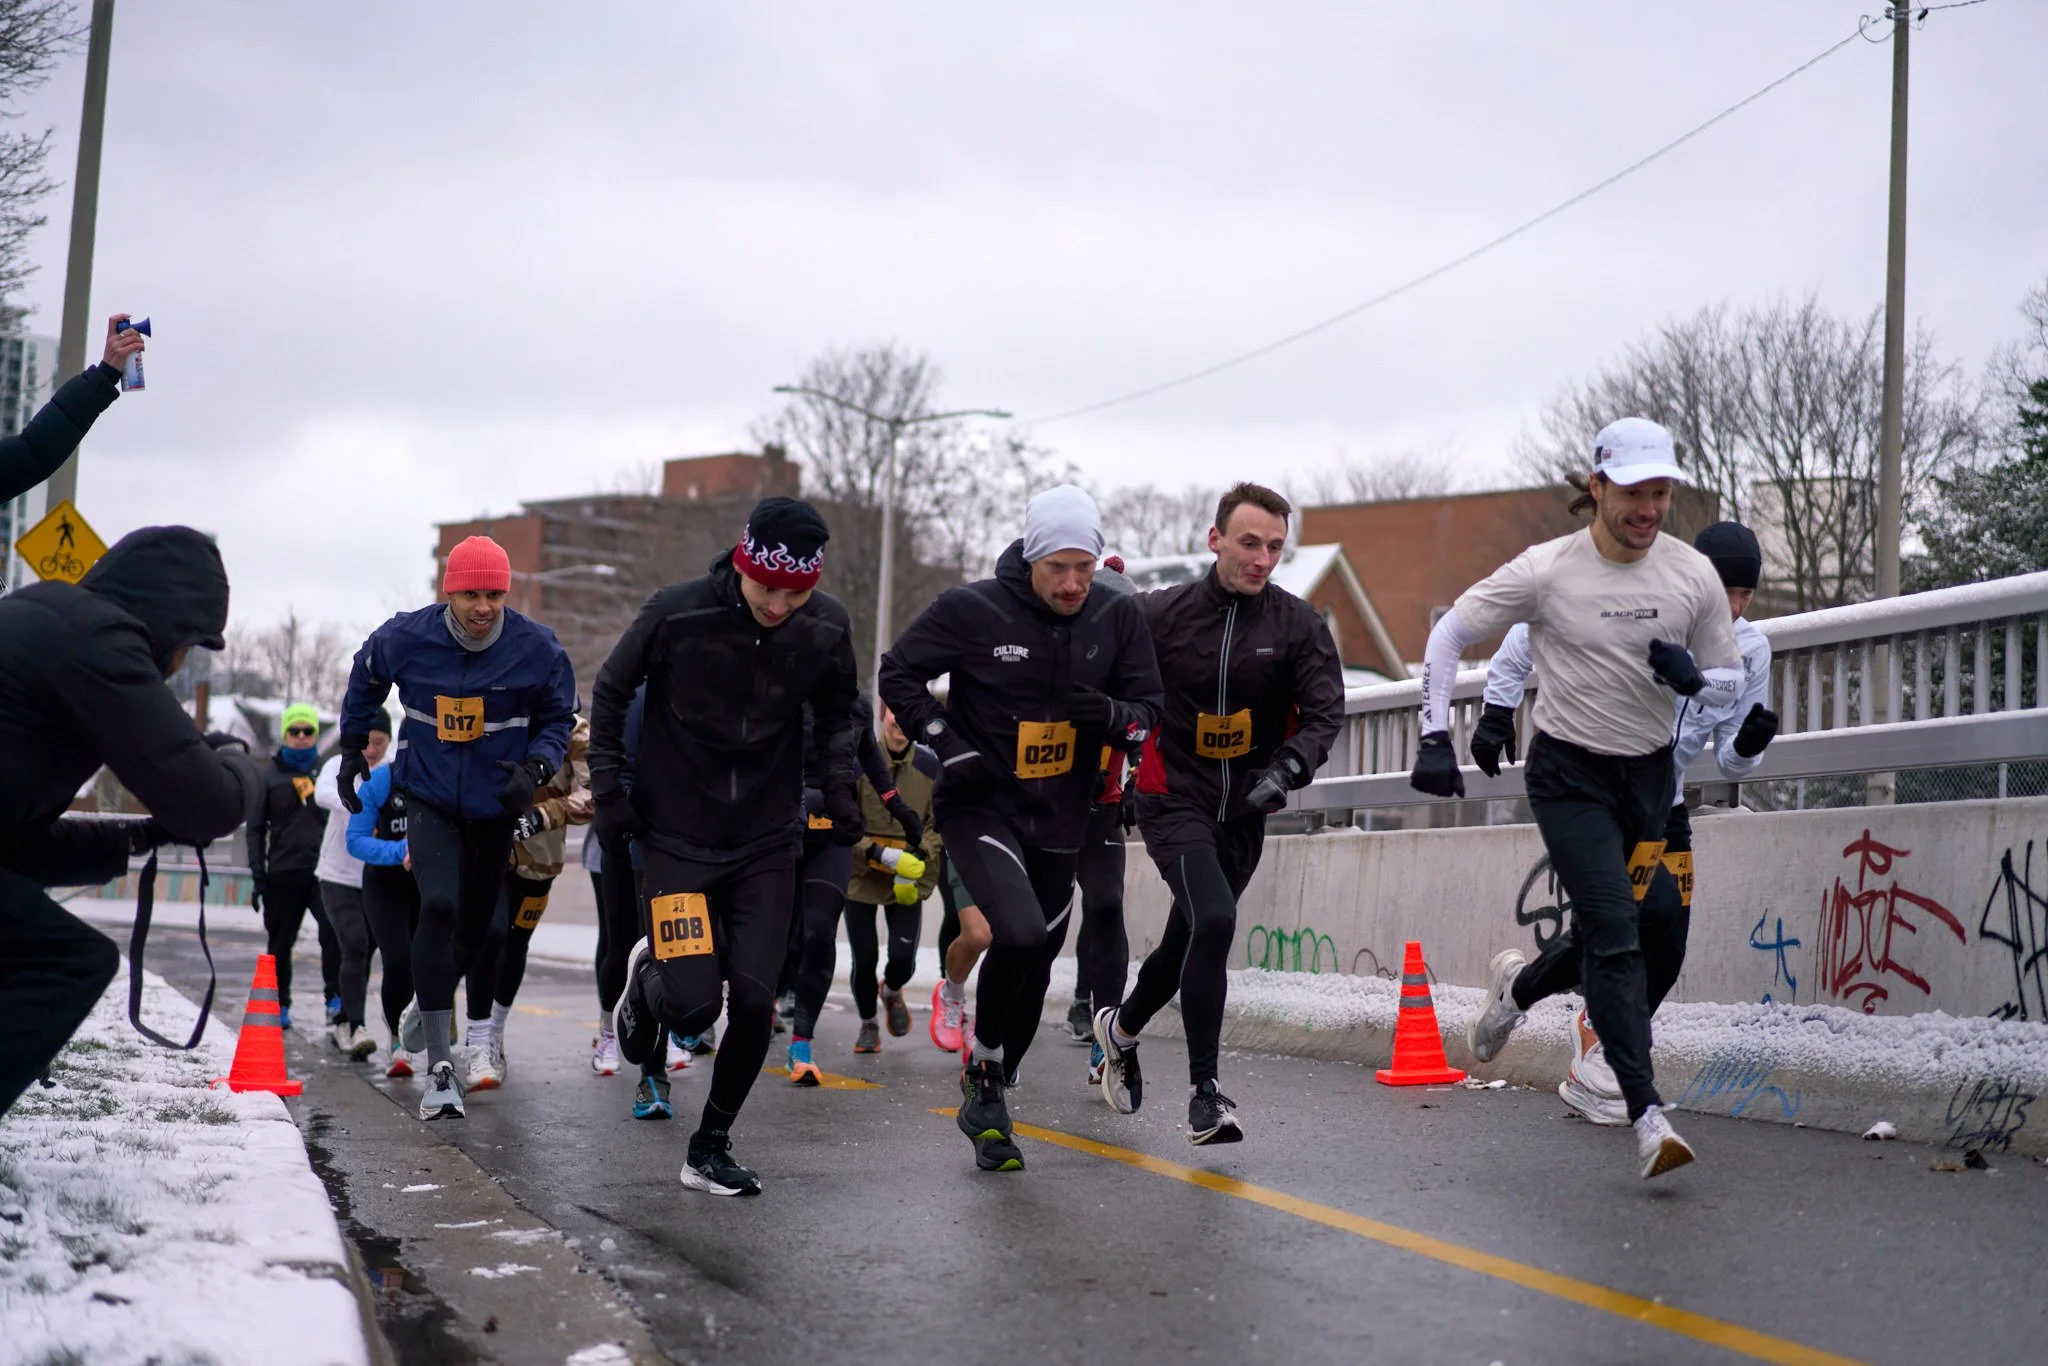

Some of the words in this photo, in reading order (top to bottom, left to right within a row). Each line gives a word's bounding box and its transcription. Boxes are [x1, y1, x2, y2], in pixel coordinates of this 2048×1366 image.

[993, 645, 1029, 659] CULTURE
[1423, 663, 1431, 706] TERREX
[1711, 680, 1737, 693] TERREX
[444, 714, 476, 731] 017
[1203, 730, 1245, 748] 002
[1024, 742, 1068, 765] 020
[1671, 872, 1694, 893] 15
[660, 916, 704, 943] 008
